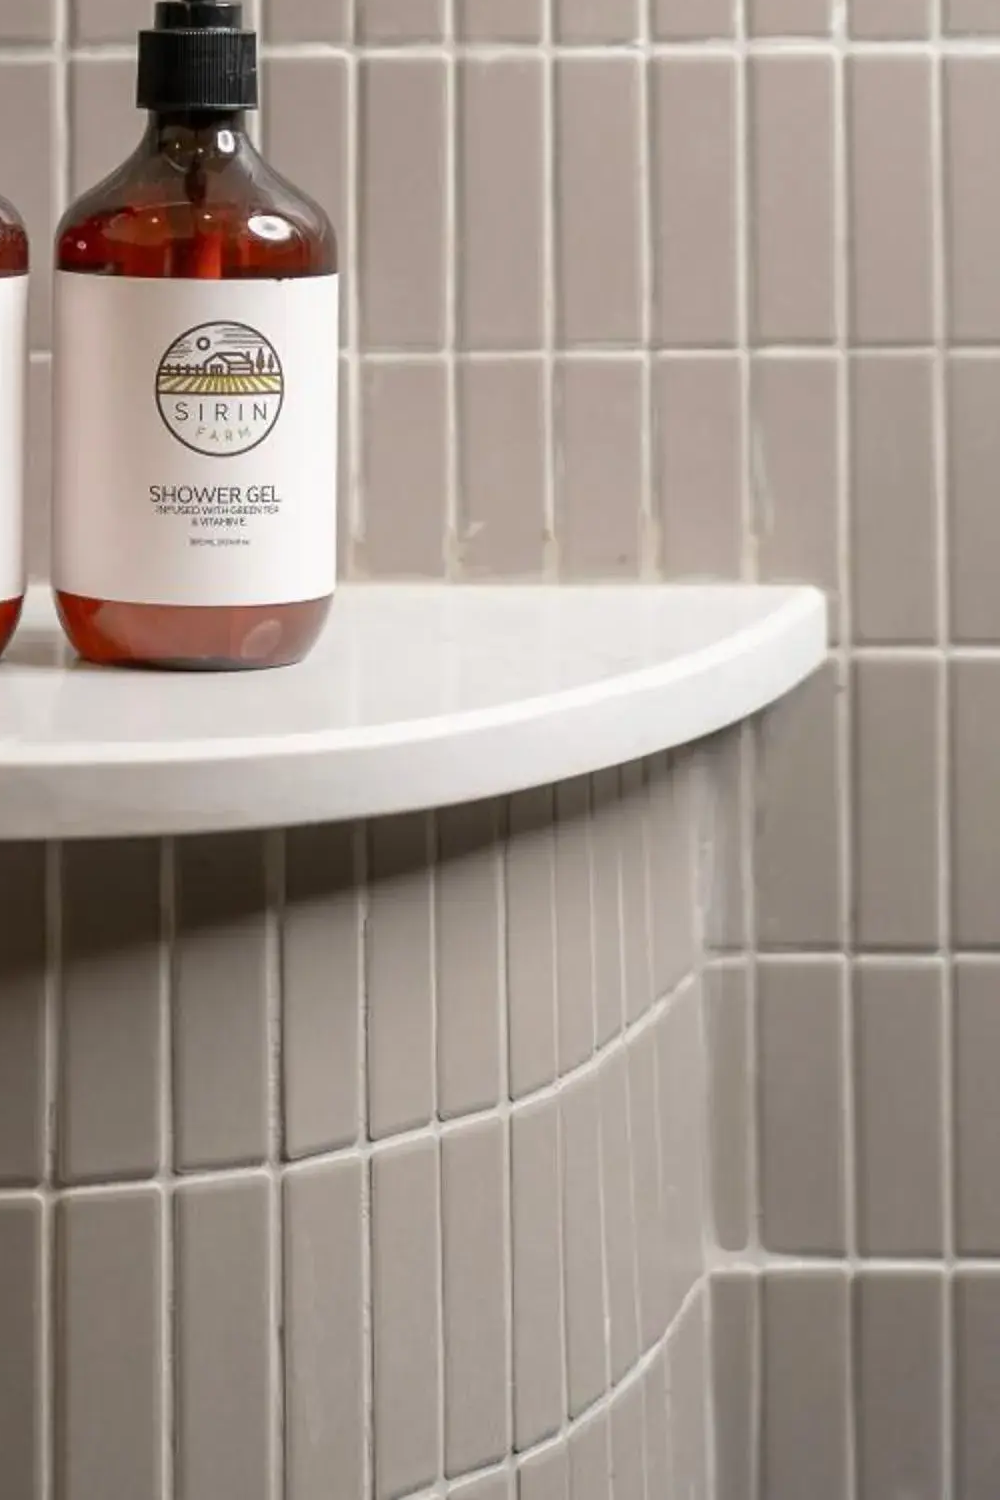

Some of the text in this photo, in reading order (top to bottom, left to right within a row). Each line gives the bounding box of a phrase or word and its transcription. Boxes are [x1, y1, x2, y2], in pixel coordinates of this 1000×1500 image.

[174, 402, 268, 422] SIRIN
[195, 426, 251, 443] FARM
[149, 484, 282, 504] SHOWER GEL
[202, 505, 229, 516] WITH
